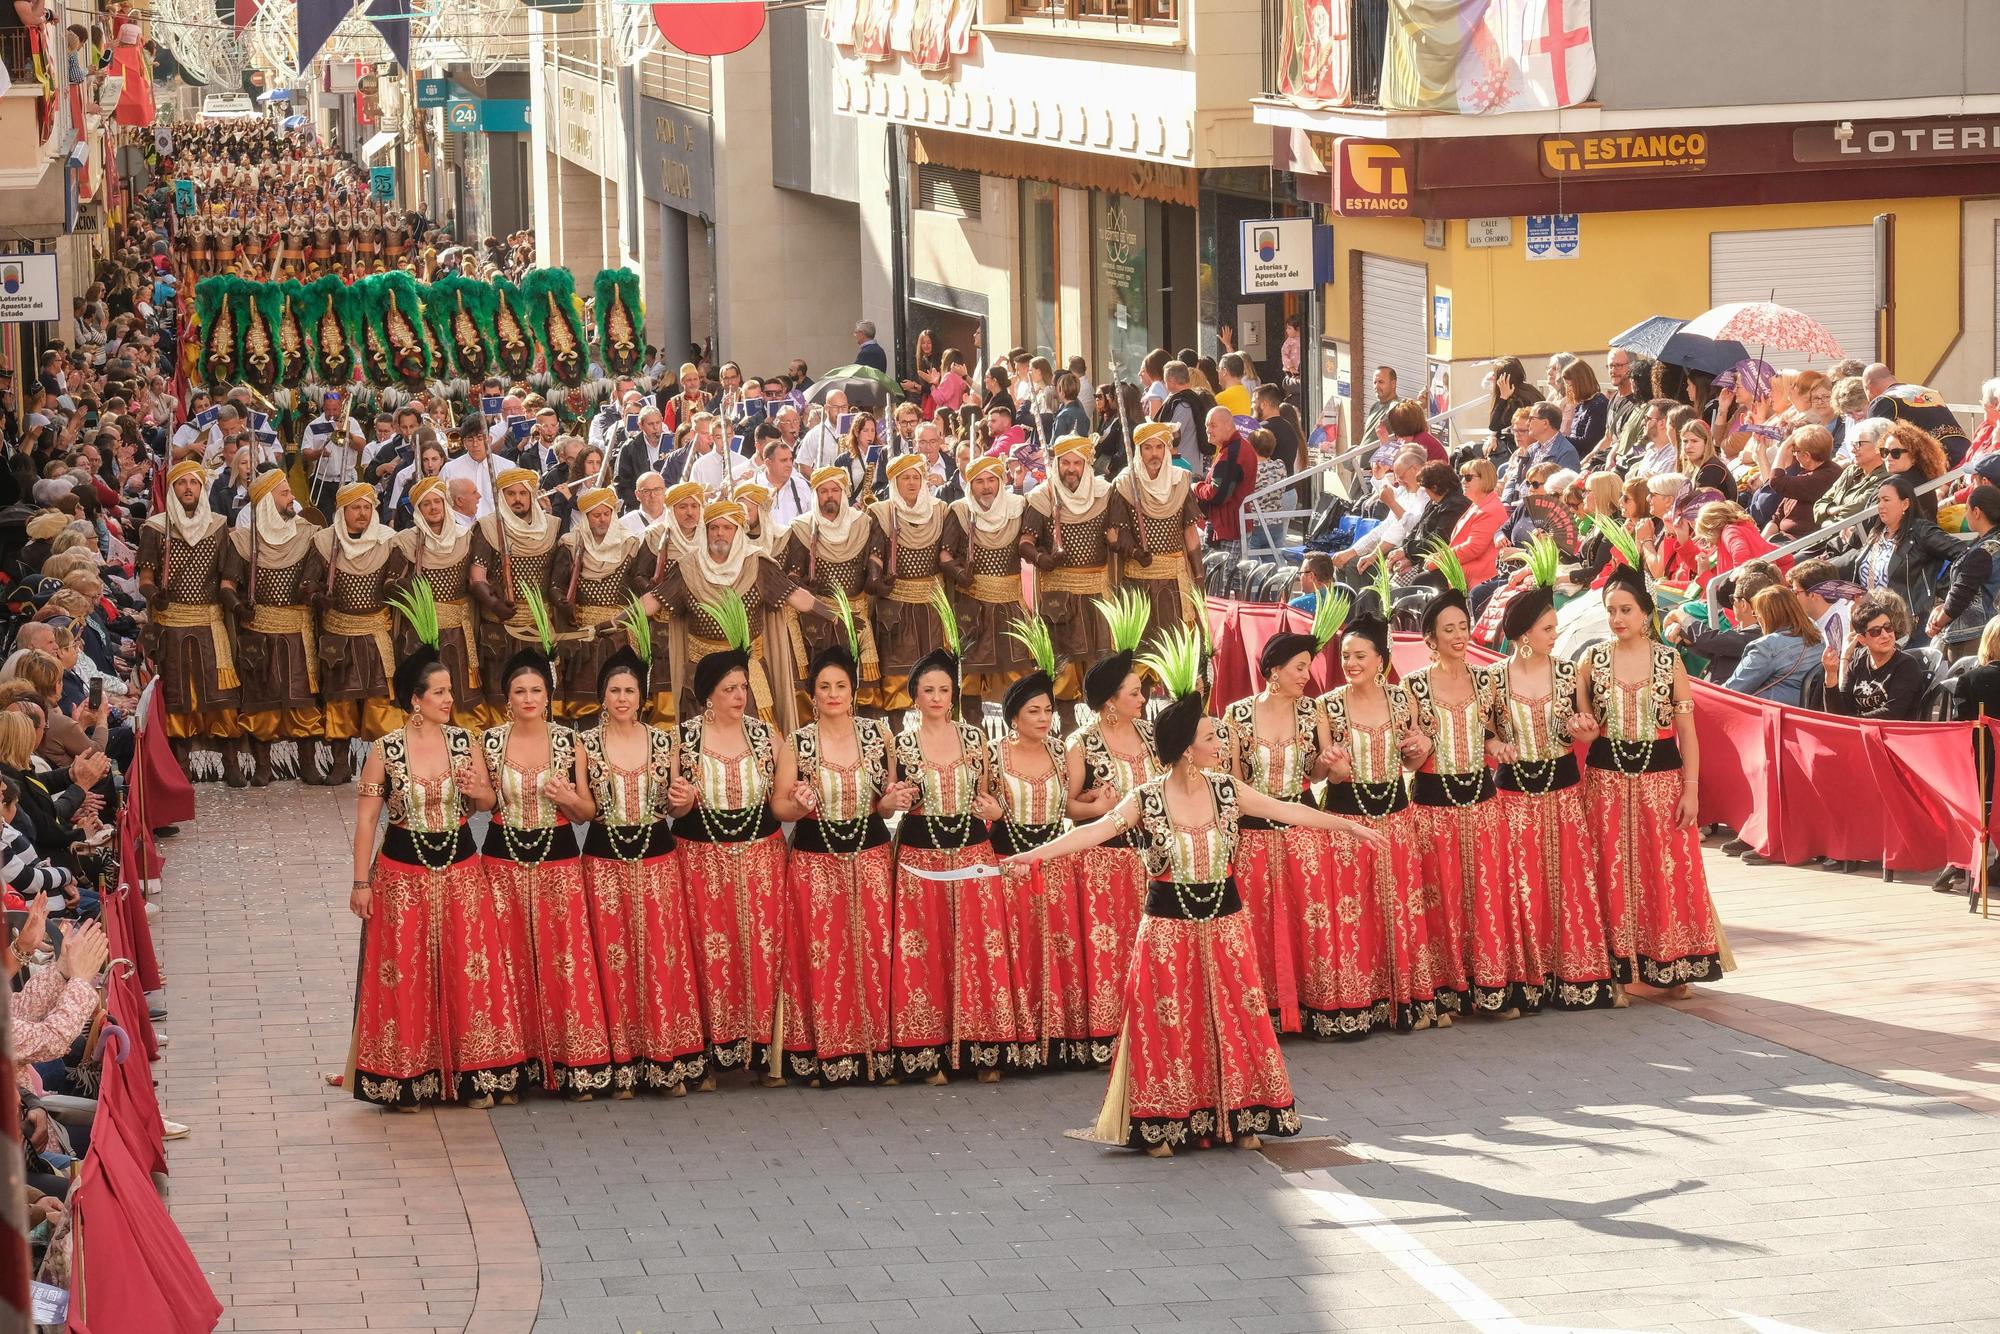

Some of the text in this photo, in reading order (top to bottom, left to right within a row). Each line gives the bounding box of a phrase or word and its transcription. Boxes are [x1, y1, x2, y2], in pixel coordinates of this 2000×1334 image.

[1584, 134, 1705, 160] ESTANCO
[1346, 198, 1408, 210] ESTANCO
[1481, 220, 1498, 228] CALLE
[1470, 235, 1509, 244] LUIS CHORRO
[1255, 271, 1287, 280] Apuestas
